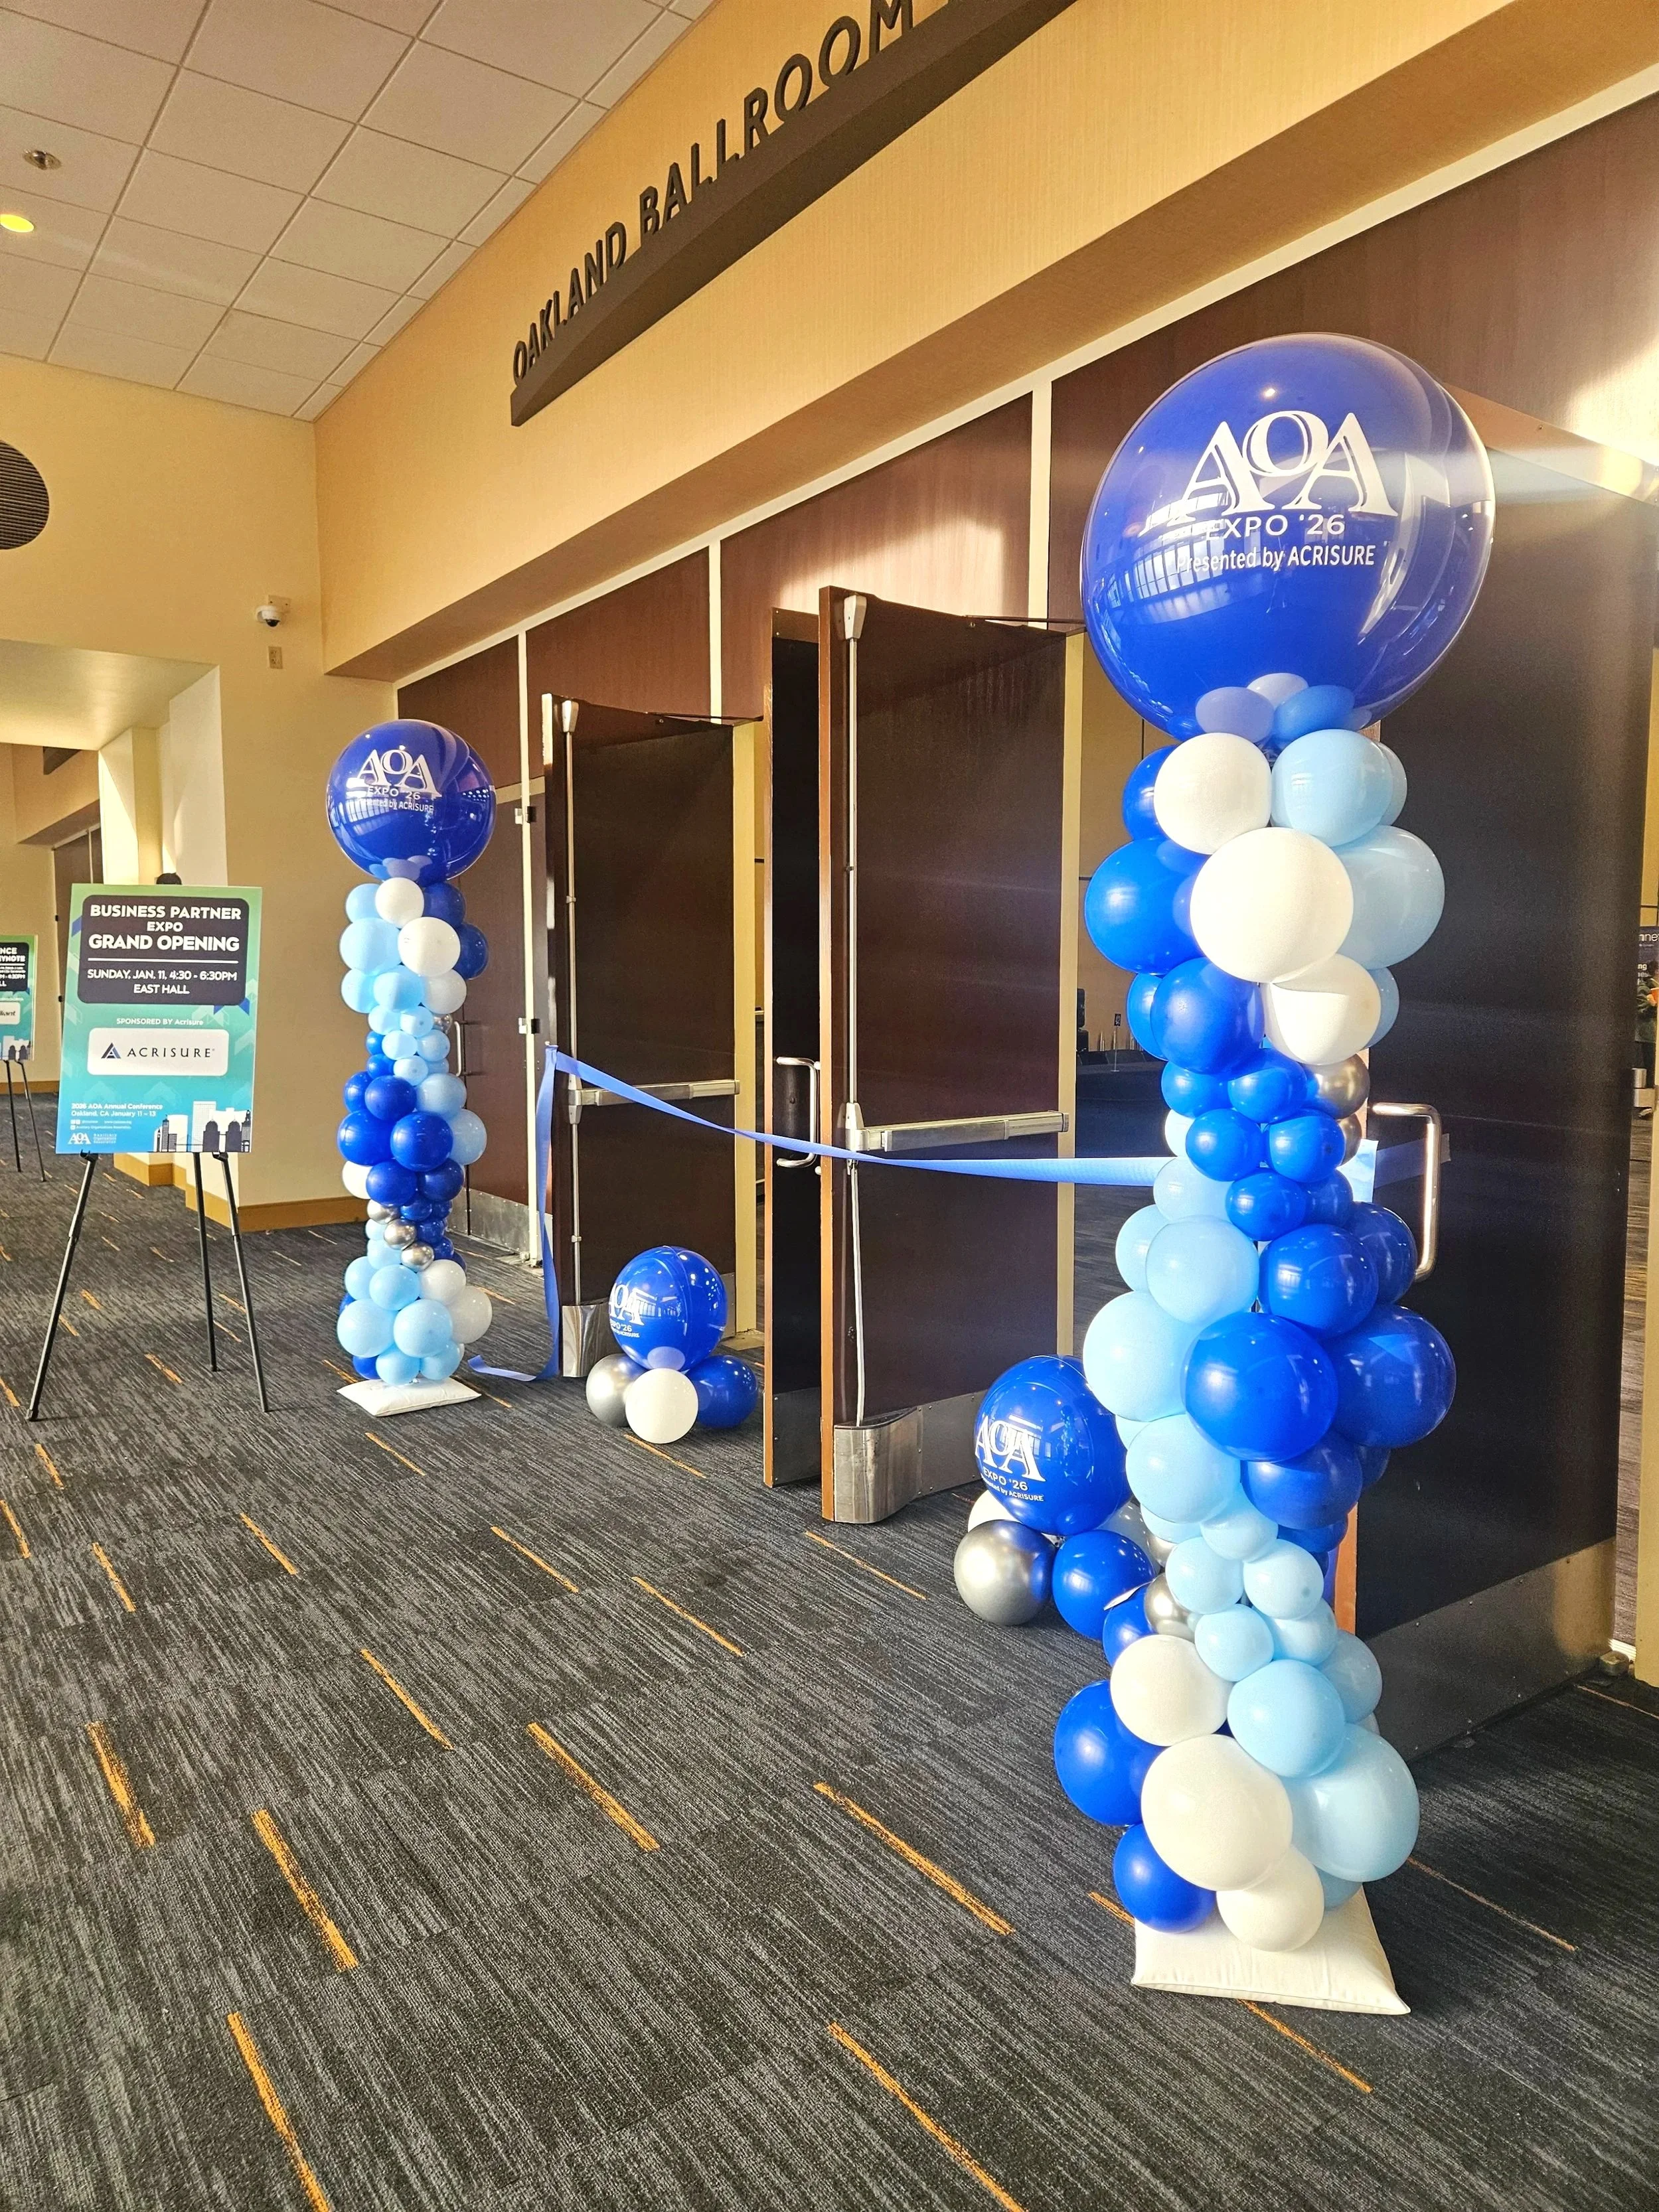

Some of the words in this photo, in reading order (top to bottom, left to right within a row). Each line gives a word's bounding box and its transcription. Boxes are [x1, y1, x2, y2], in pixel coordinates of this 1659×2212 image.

[512, 222, 627, 388] OAKLAND
[639, 0, 914, 248] BALLROOM
[1166, 410, 1398, 526] AOA
[1206, 514, 1288, 540] EXPO
[1299, 514, 1346, 536] '26
[1176, 546, 1257, 574] Presented
[1262, 546, 1285, 571] by
[1288, 544, 1376, 567] ACRISURE
[353, 749, 443, 798] AOA
[367, 786, 399, 797] EXPO
[404, 791, 421, 800] 26
[388, 799, 398, 810] by
[398, 800, 434, 814] ACRISURE
[90, 905, 166, 919] BUSINESS
[170, 906, 242, 921] PARTNER
[147, 921, 183, 932] EXPO
[88, 934, 153, 950] GRAND
[157, 936, 240, 952] OPENING
[132, 970, 156, 980] JAN.
[169, 970, 192, 980] 4:30
[199, 971, 238, 982] 6:30PM
[133, 984, 161, 994] EAST
[161, 984, 190, 995] HALL
[127, 1047, 211, 1058] ACRISURE
[68, 1132, 92, 1145] AOA
[975, 1415, 1046, 1482] AOA
[983, 1465, 1007, 1486] EXPO
[1008, 1478, 1028, 1491] '26
[1008, 1490, 1044, 1502] ACRISURE
